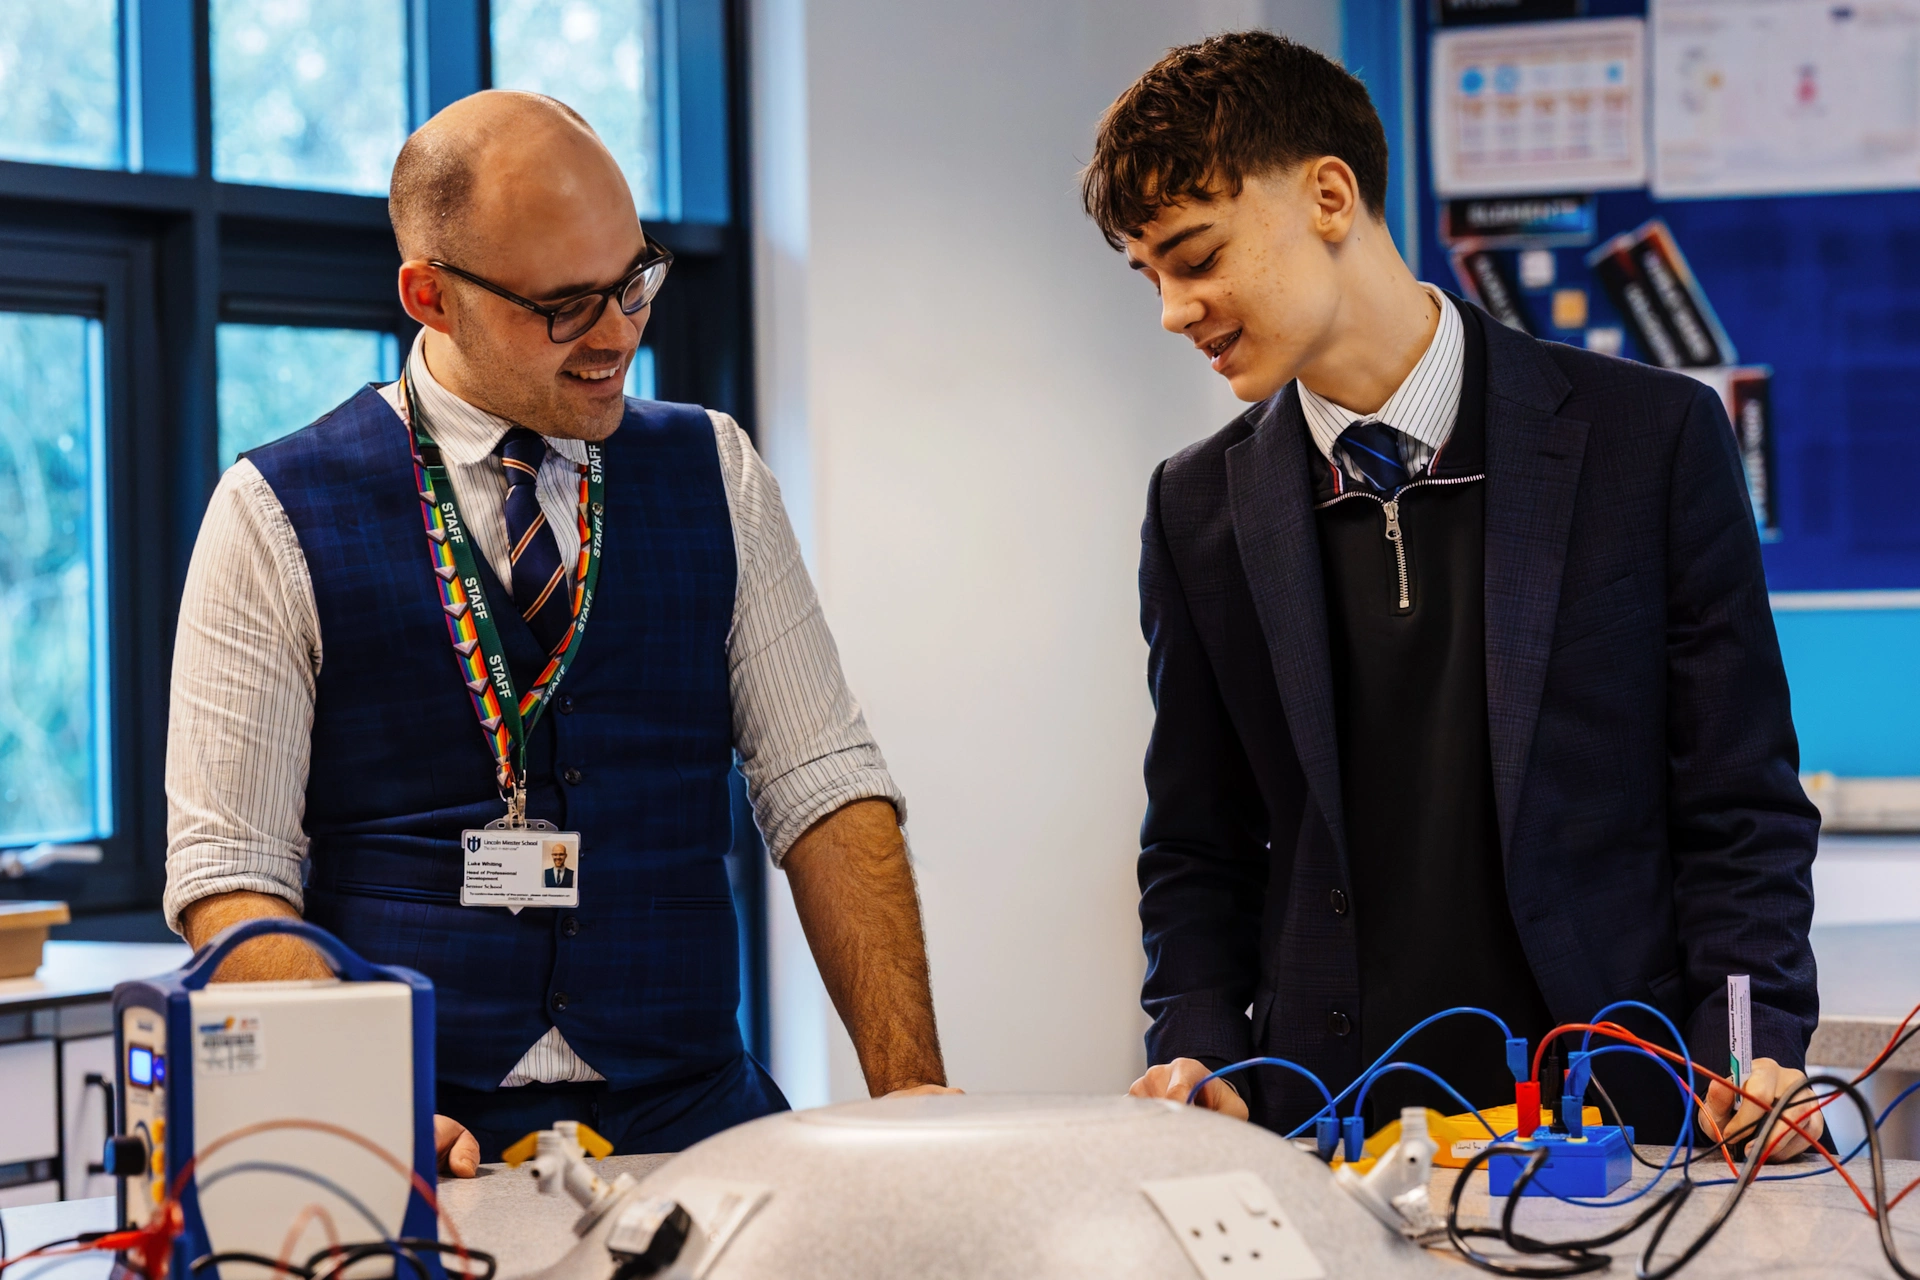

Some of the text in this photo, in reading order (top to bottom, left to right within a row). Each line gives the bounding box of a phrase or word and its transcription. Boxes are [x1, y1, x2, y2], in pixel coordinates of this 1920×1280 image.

[588, 444, 602, 484] STAFF
[441, 501, 464, 545] STAFF
[593, 516, 604, 558] STAFF
[464, 576, 488, 620] STAFF
[577, 588, 593, 633] STAFF
[489, 654, 512, 699] STAFF
[542, 664, 567, 706] STAFF
